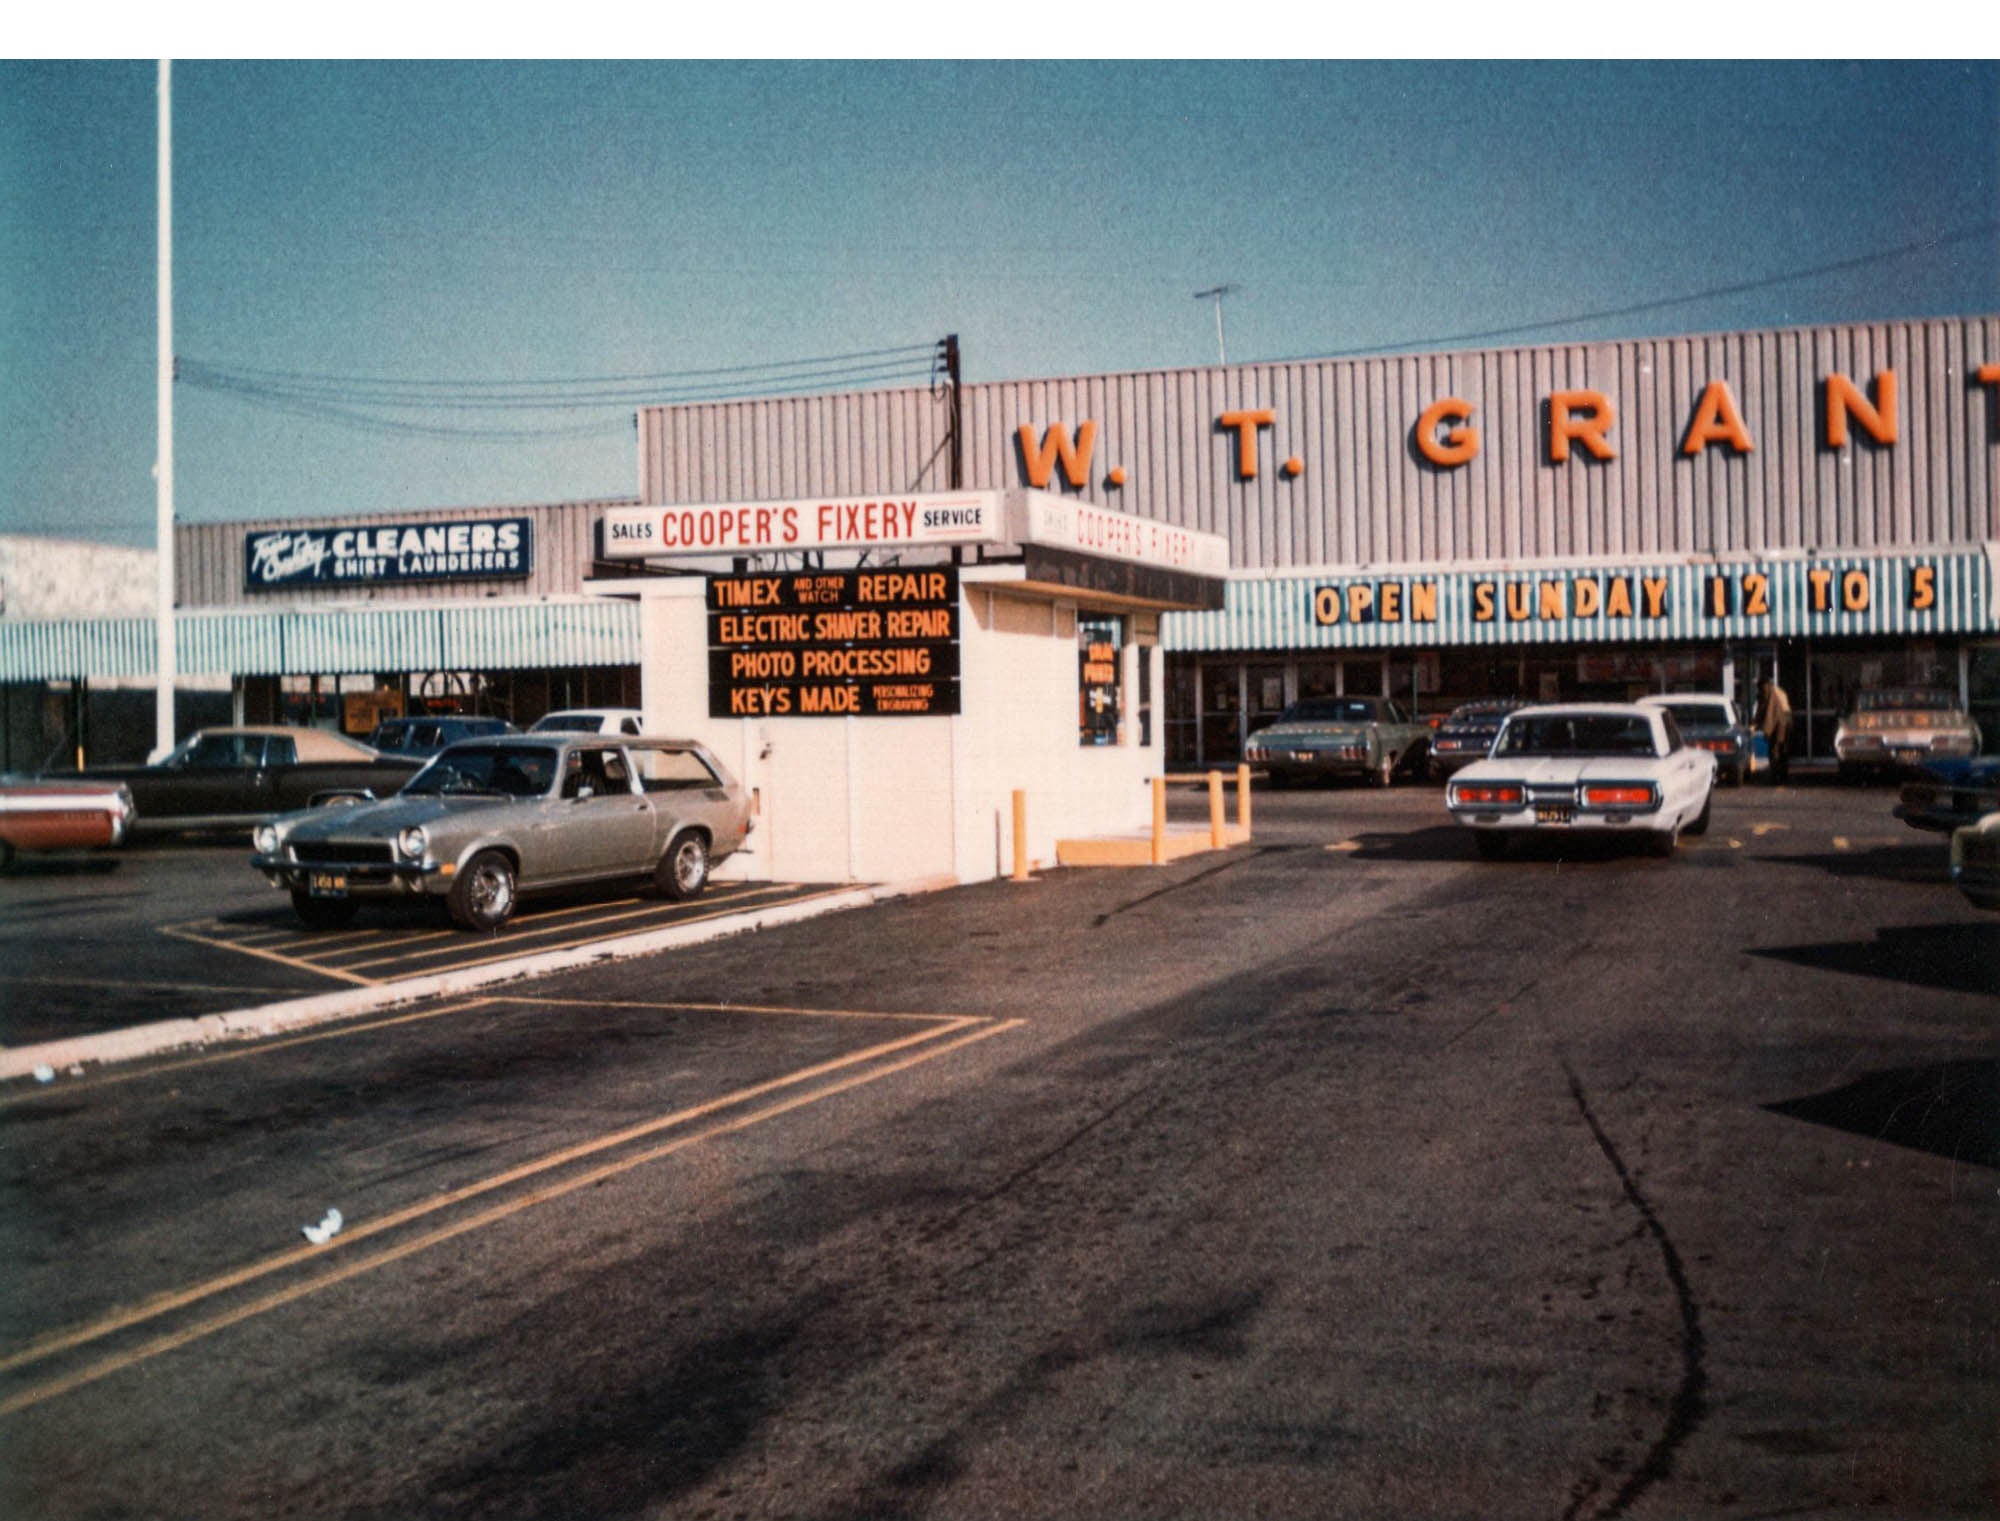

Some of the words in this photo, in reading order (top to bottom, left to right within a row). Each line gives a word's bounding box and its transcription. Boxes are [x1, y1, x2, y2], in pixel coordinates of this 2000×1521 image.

[1018, 419, 1127, 488] W.
[1220, 409, 1305, 477] T.
[332, 523, 520, 559] CLEANERS
[612, 523, 652, 539] SALES
[661, 506, 800, 549] COOPER'S
[816, 500, 918, 543] FIXERY
[924, 509, 981, 527] SERVICE
[334, 557, 387, 577] SHIRT
[398, 551, 519, 574] LAUNDERERS
[713, 578, 781, 606] TIMEX
[858, 572, 947, 602] REPAIR
[793, 577, 813, 590] AND
[815, 576, 845, 590] OTHER
[798, 590, 839, 604] WATCH
[1316, 583, 1436, 624] OPEN
[1476, 578, 1667, 621] SUNDAY
[1712, 574, 1769, 617] 12
[1810, 570, 1869, 612] TO
[1913, 567, 1934, 610] 5
[719, 613, 810, 643] ELECTRIC
[814, 610, 882, 641] SHAVER
[886, 609, 951, 639] REPAIR
[731, 651, 796, 678] PHOTO
[802, 647, 931, 677] PROCESSING
[731, 686, 792, 715] KEYS
[799, 685, 861, 713] MADE
